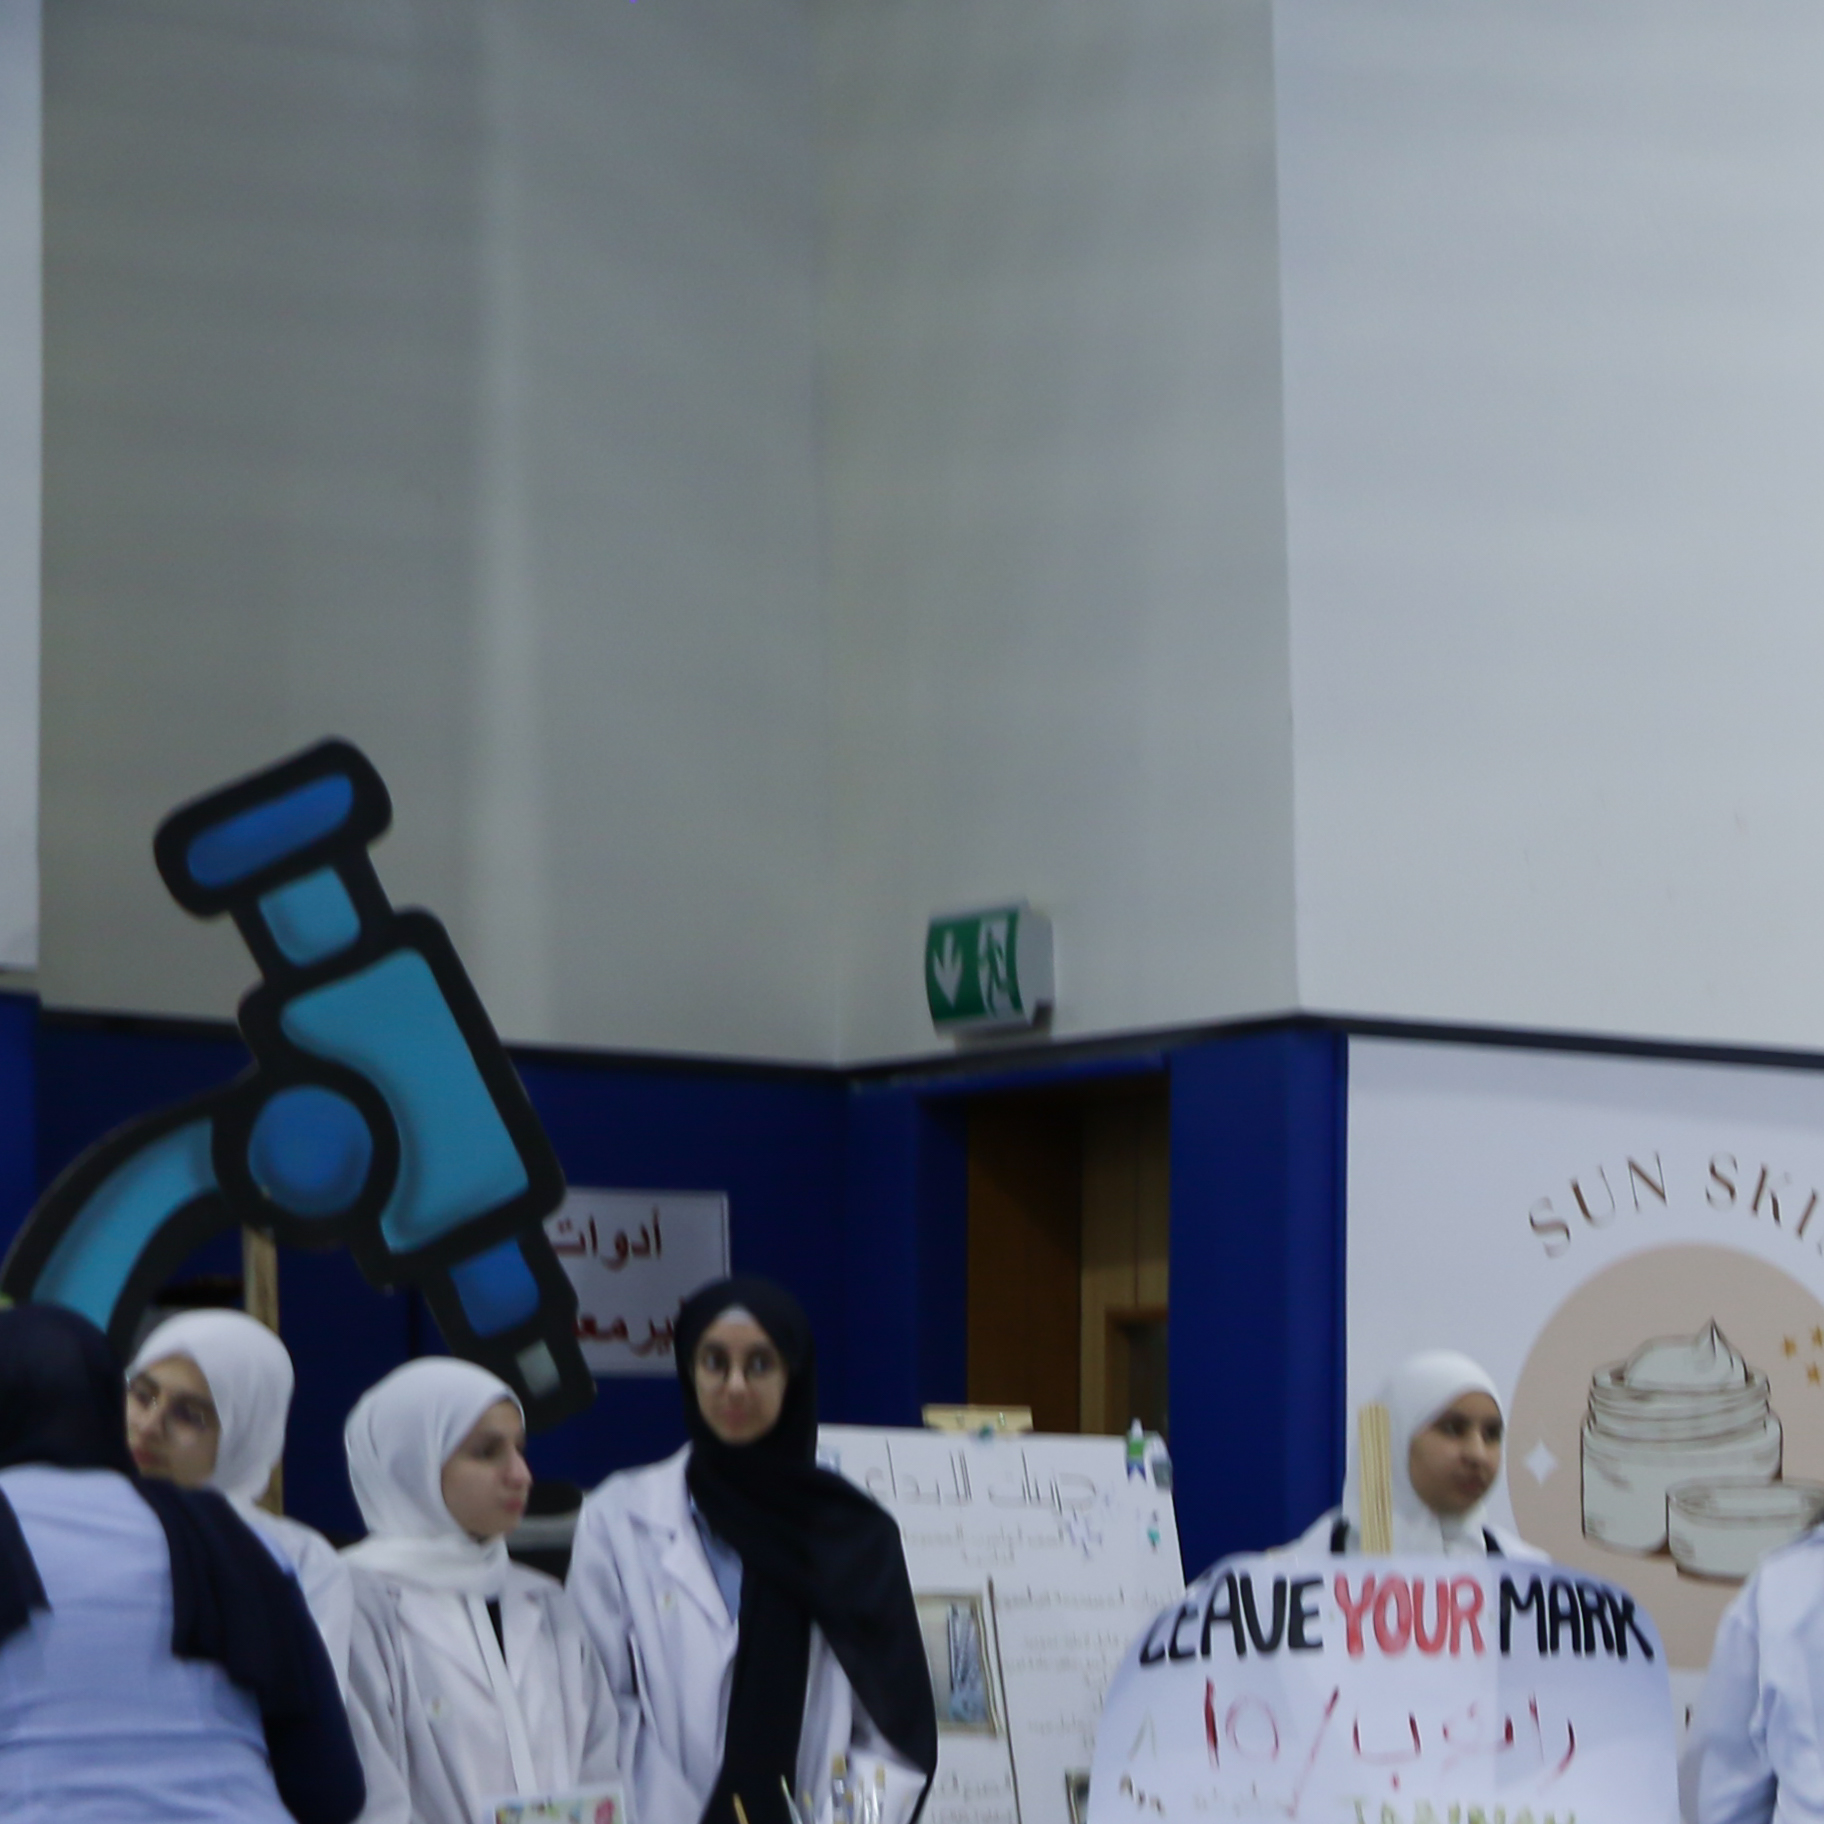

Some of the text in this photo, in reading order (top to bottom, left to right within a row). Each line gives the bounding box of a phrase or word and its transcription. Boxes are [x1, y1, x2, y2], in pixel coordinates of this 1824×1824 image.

[1527, 1150, 1669, 1258] SUN
[1138, 1572, 1324, 1667] LEAVE
[1334, 1572, 1486, 1661] YOUR
[1499, 1572, 1655, 1663] MARK
